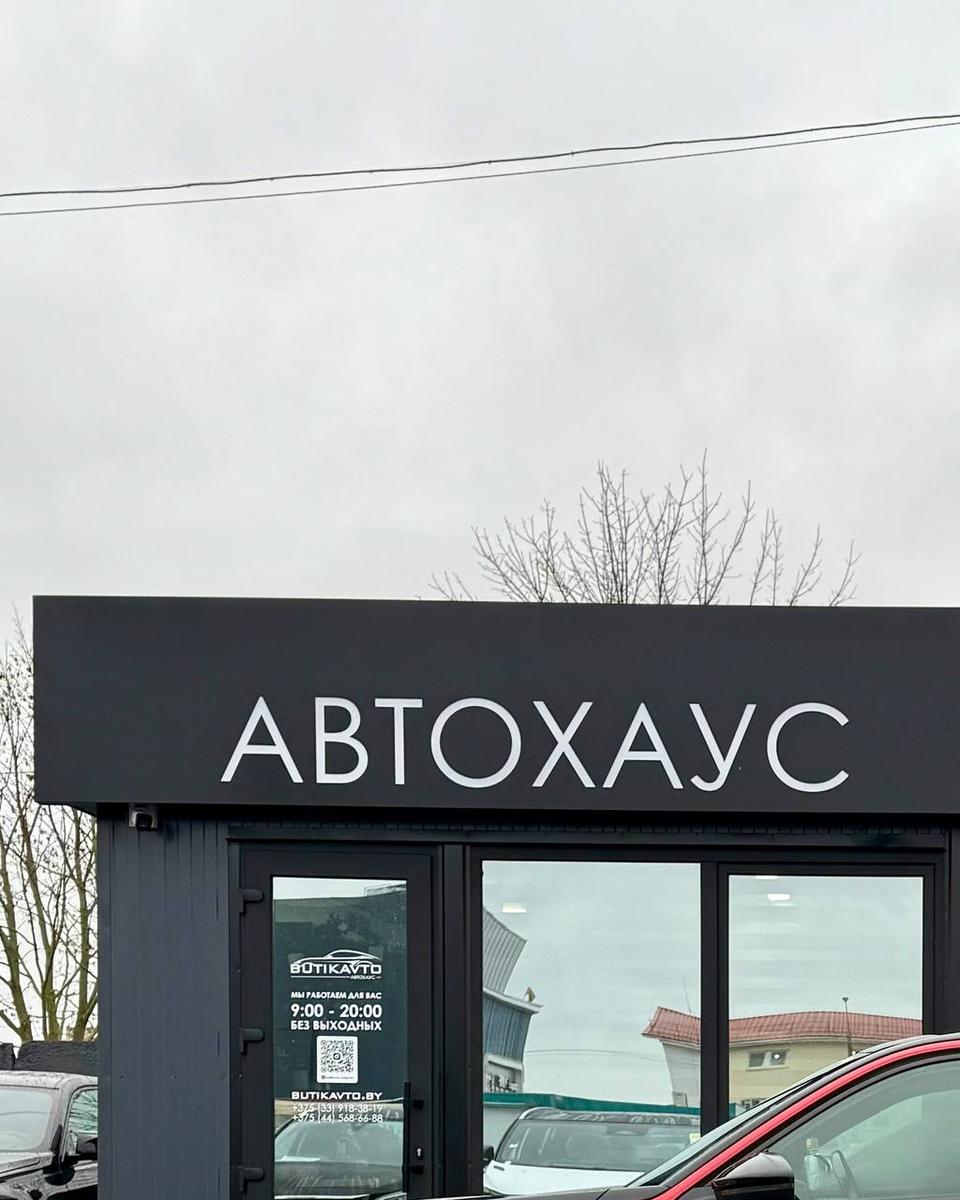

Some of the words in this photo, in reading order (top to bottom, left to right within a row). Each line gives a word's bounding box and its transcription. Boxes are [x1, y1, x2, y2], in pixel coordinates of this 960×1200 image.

[221, 696, 849, 793] АВТОХАУС
[290, 964, 382, 974] BUTIKAVTO
[290, 991, 305, 999] МЫ
[306, 991, 347, 999] РАБОТАЕМ
[347, 991, 365, 1000] ДЛЯ
[365, 992, 382, 1000] ВАС
[290, 1003, 324, 1018] 9:00
[340, 1004, 383, 1018] 20:00
[290, 1020, 310, 1030] БЕЗ
[312, 1020, 383, 1032] ВЫХОДНЫХ
[291, 1091, 383, 1100] BUTIKAVTO.BY
[337, 1103, 383, 1113] 918-38-19
[338, 1113, 384, 1123] 568-66-88
